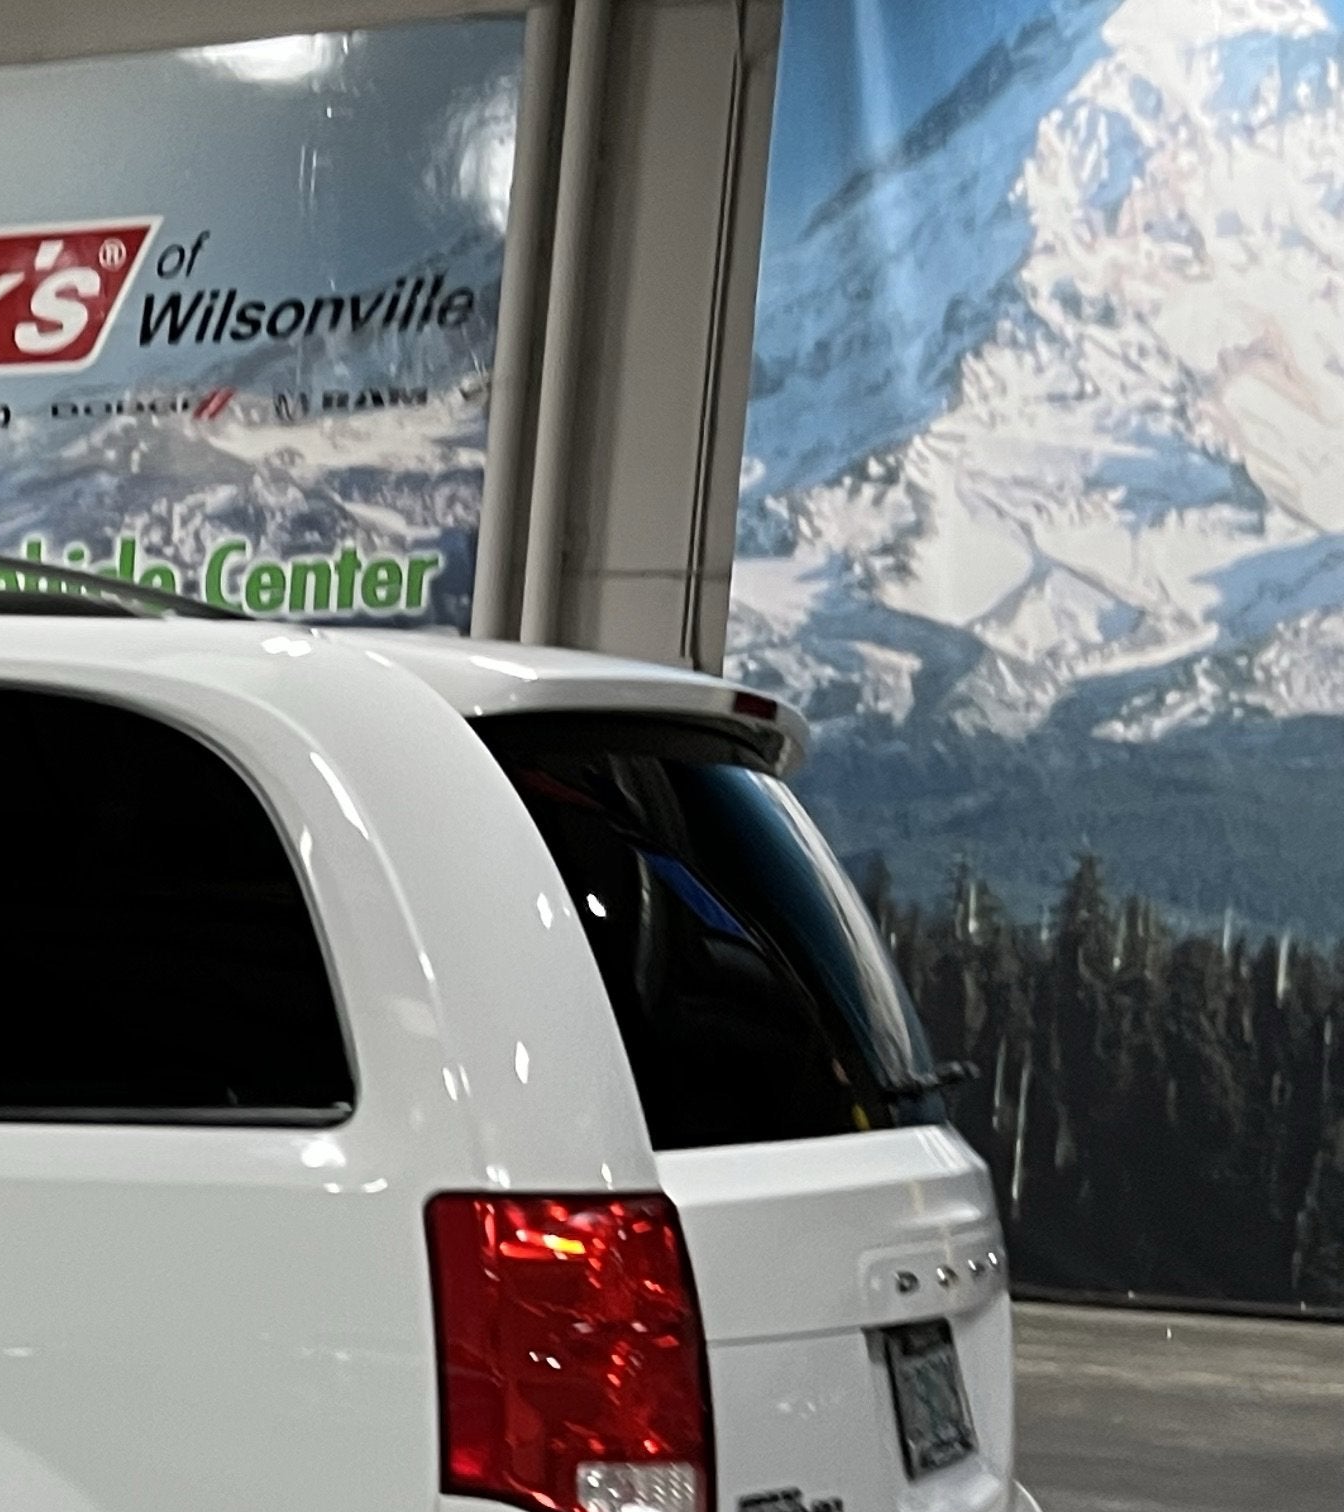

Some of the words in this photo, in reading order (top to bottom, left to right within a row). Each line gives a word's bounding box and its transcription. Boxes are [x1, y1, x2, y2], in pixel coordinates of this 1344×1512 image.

[157, 230, 210, 279] of
[139, 270, 475, 347] Wilsonville
[205, 539, 440, 614] Center
